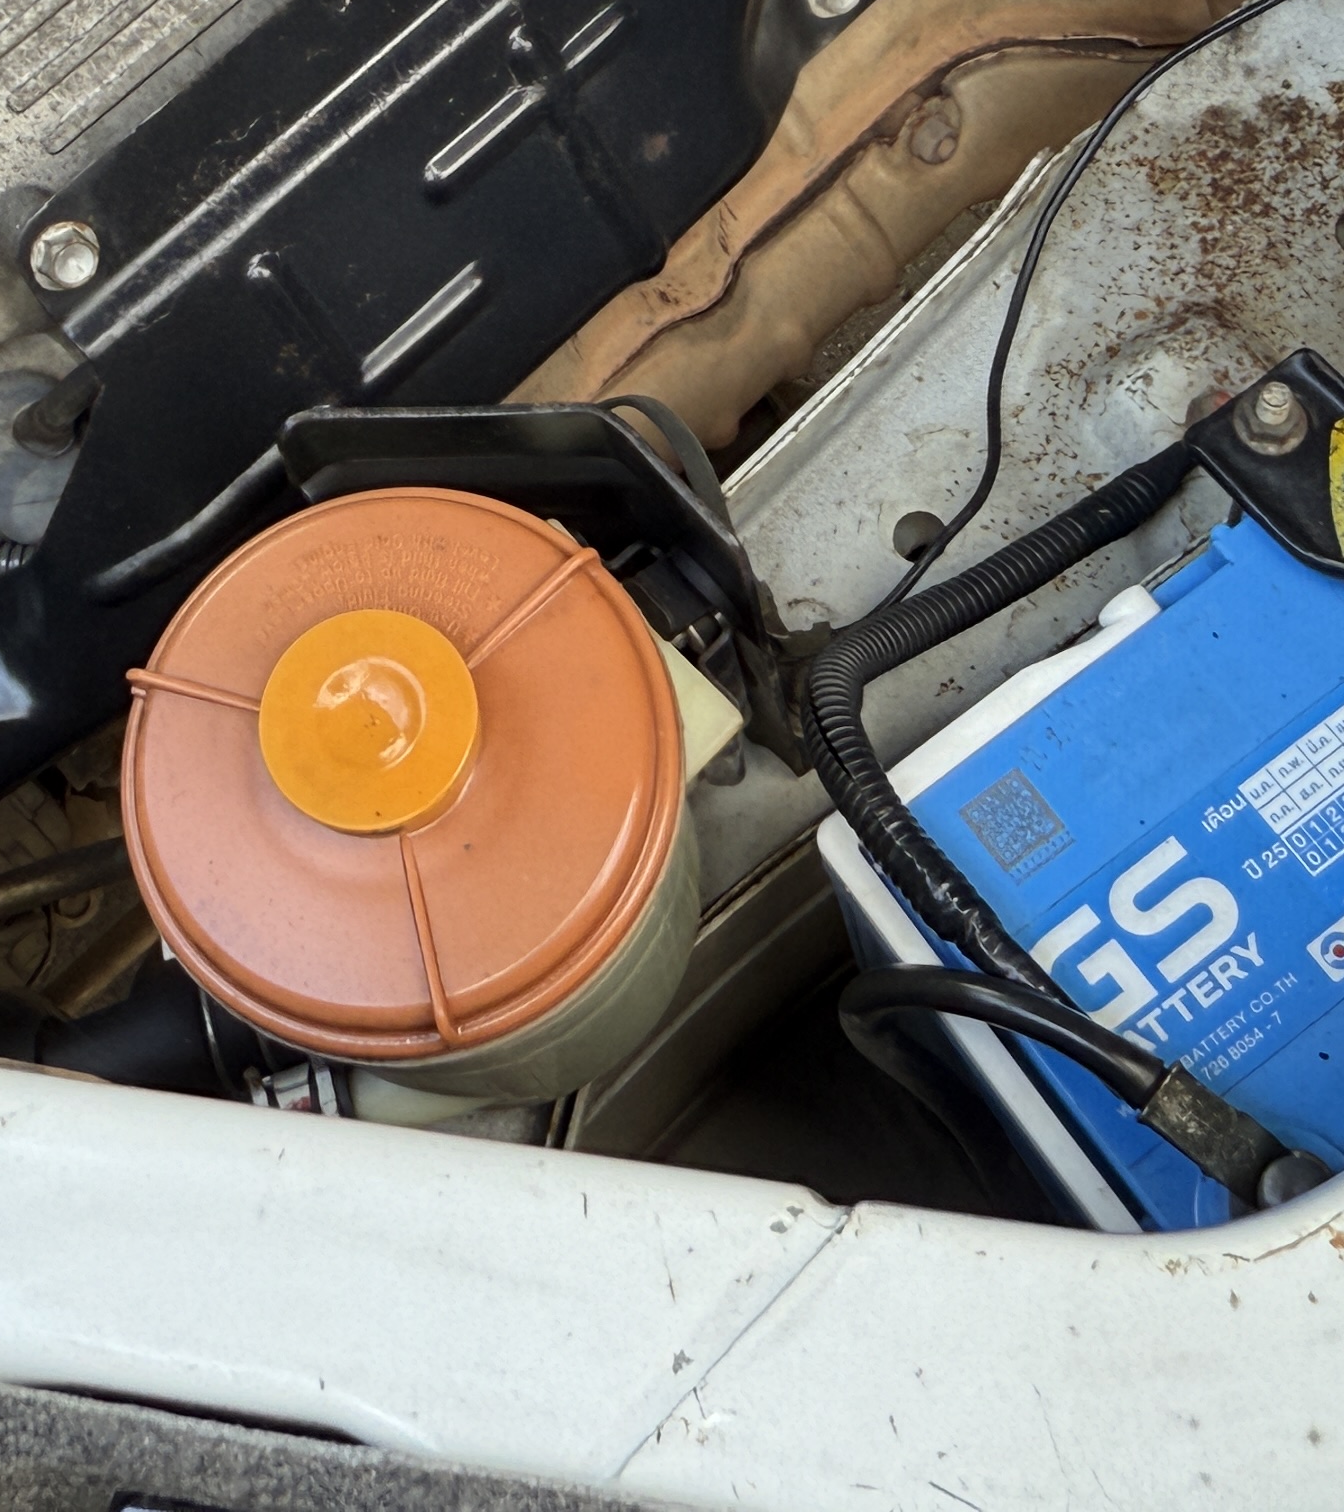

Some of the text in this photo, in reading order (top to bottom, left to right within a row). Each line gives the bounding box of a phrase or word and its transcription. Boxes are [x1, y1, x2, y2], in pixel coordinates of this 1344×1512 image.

[1201, 793, 1247, 832] เดือน
[1241, 858, 1262, 879] ปี
[1261, 842, 1288, 868] 25
[1291, 832, 1306, 847] 0
[1309, 820, 1322, 833] 1
[1325, 806, 1341, 822] 2
[1306, 850, 1321, 865] 0
[1324, 837, 1337, 850] 1
[1031, 834, 1240, 1031] GS
[1270, 1010, 1281, 1024] 7
